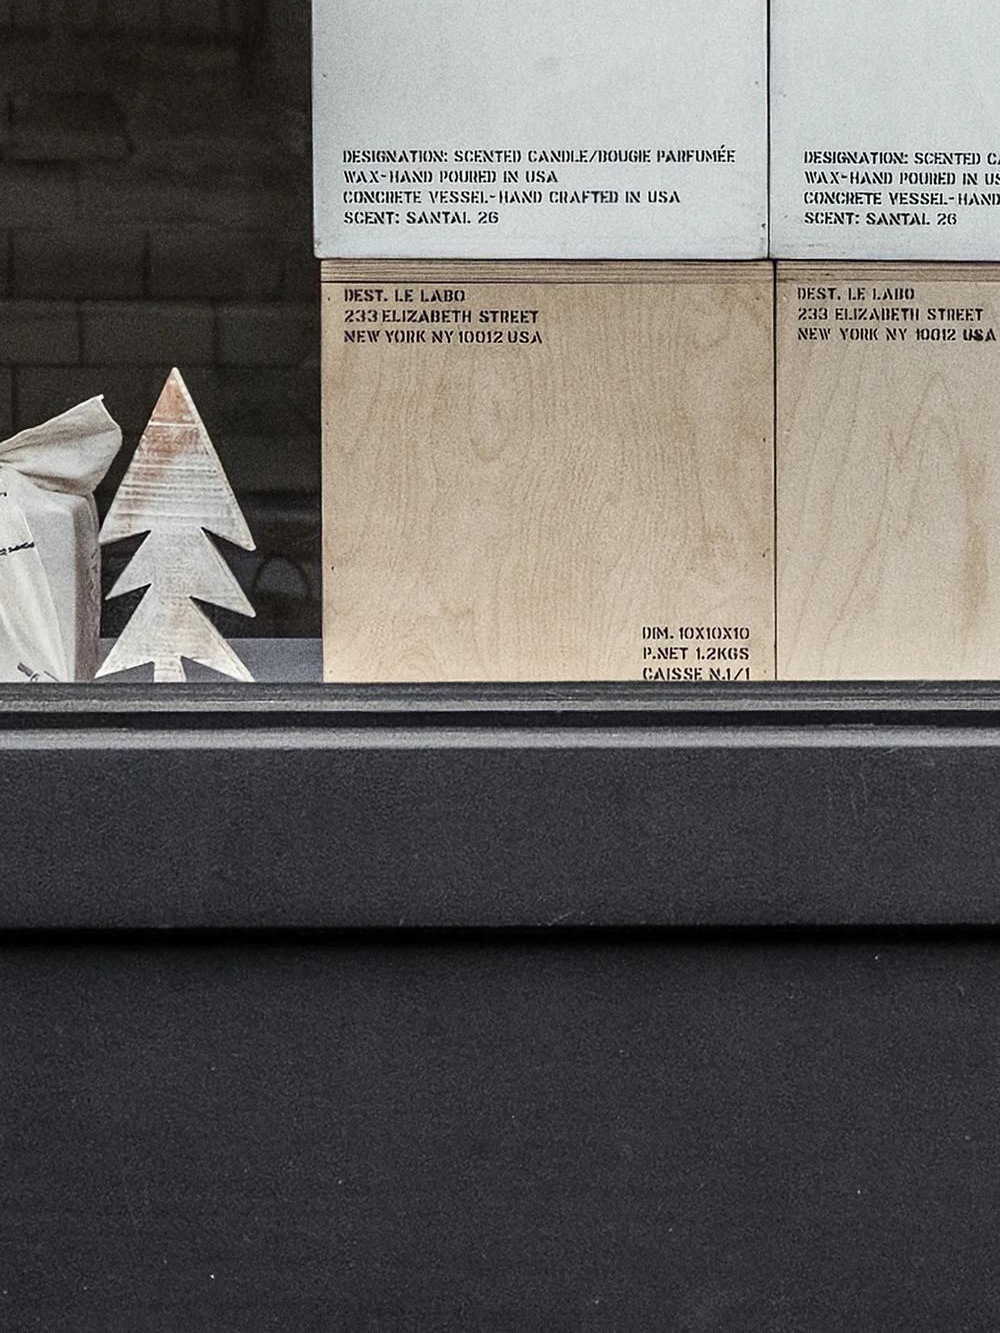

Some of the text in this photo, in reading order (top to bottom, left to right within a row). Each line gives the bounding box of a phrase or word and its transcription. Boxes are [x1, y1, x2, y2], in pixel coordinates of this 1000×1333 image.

[342, 145, 737, 164] DESIGNATION: SCENTED CANDLE/BOUGIE PARFUMÉE
[803, 151, 908, 165] DESIGNATION:
[914, 151, 981, 165] SCENTED
[343, 170, 559, 184] WAX-HAND POURED IN USA
[804, 171, 893, 185] WAX-HAND
[899, 171, 956, 185] POURED
[962, 171, 978, 186] IN
[342, 190, 681, 204] CONCRETE VESSEL-HAND CRAFTED IN USA
[803, 191, 881, 206] CONCRETE
[888, 192, 1000, 206] VESSEL-HAND
[343, 211, 499, 225] SCENT: SANTAL 26
[804, 211, 957, 226] SCENT: SANTAL 26
[344, 288, 465, 302] DEST. LE LABO
[797, 287, 915, 301] DEST. LE LABO
[344, 309, 539, 324] 233 ELIZABETH STREET
[798, 307, 984, 321] 233 ELIZABETH STREET
[344, 330, 543, 344] NEW YORK NY 10012 USA
[797, 327, 997, 342] NEW YORK NY 10012 USA
[642, 626, 750, 640] DIM. 10X10X10
[643, 647, 749, 660] P.NET 1.2KGS
[643, 667, 702, 681] CAISSE
